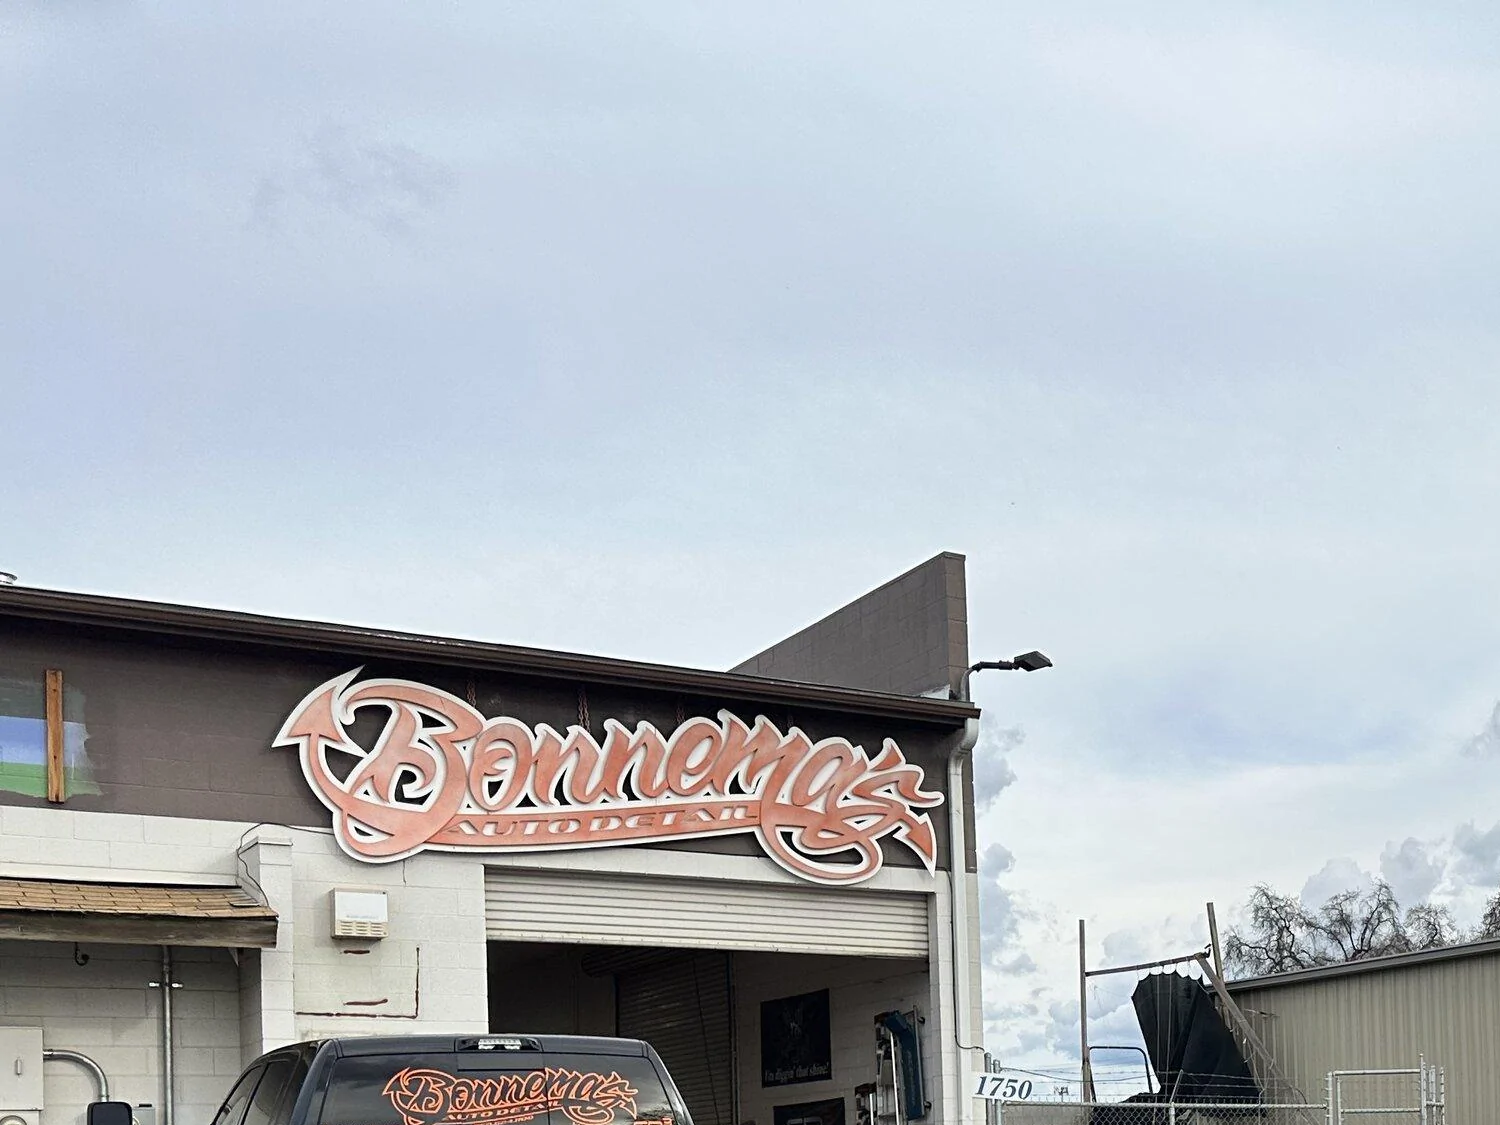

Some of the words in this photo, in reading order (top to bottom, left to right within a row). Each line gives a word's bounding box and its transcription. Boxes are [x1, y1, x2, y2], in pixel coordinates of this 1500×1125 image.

[447, 818, 581, 837] AUTO
[589, 804, 758, 832] DETAIL
[975, 1075, 1033, 1100] 1750
[444, 1110, 494, 1121] AUTO
[495, 1100, 562, 1116] DETAIL
